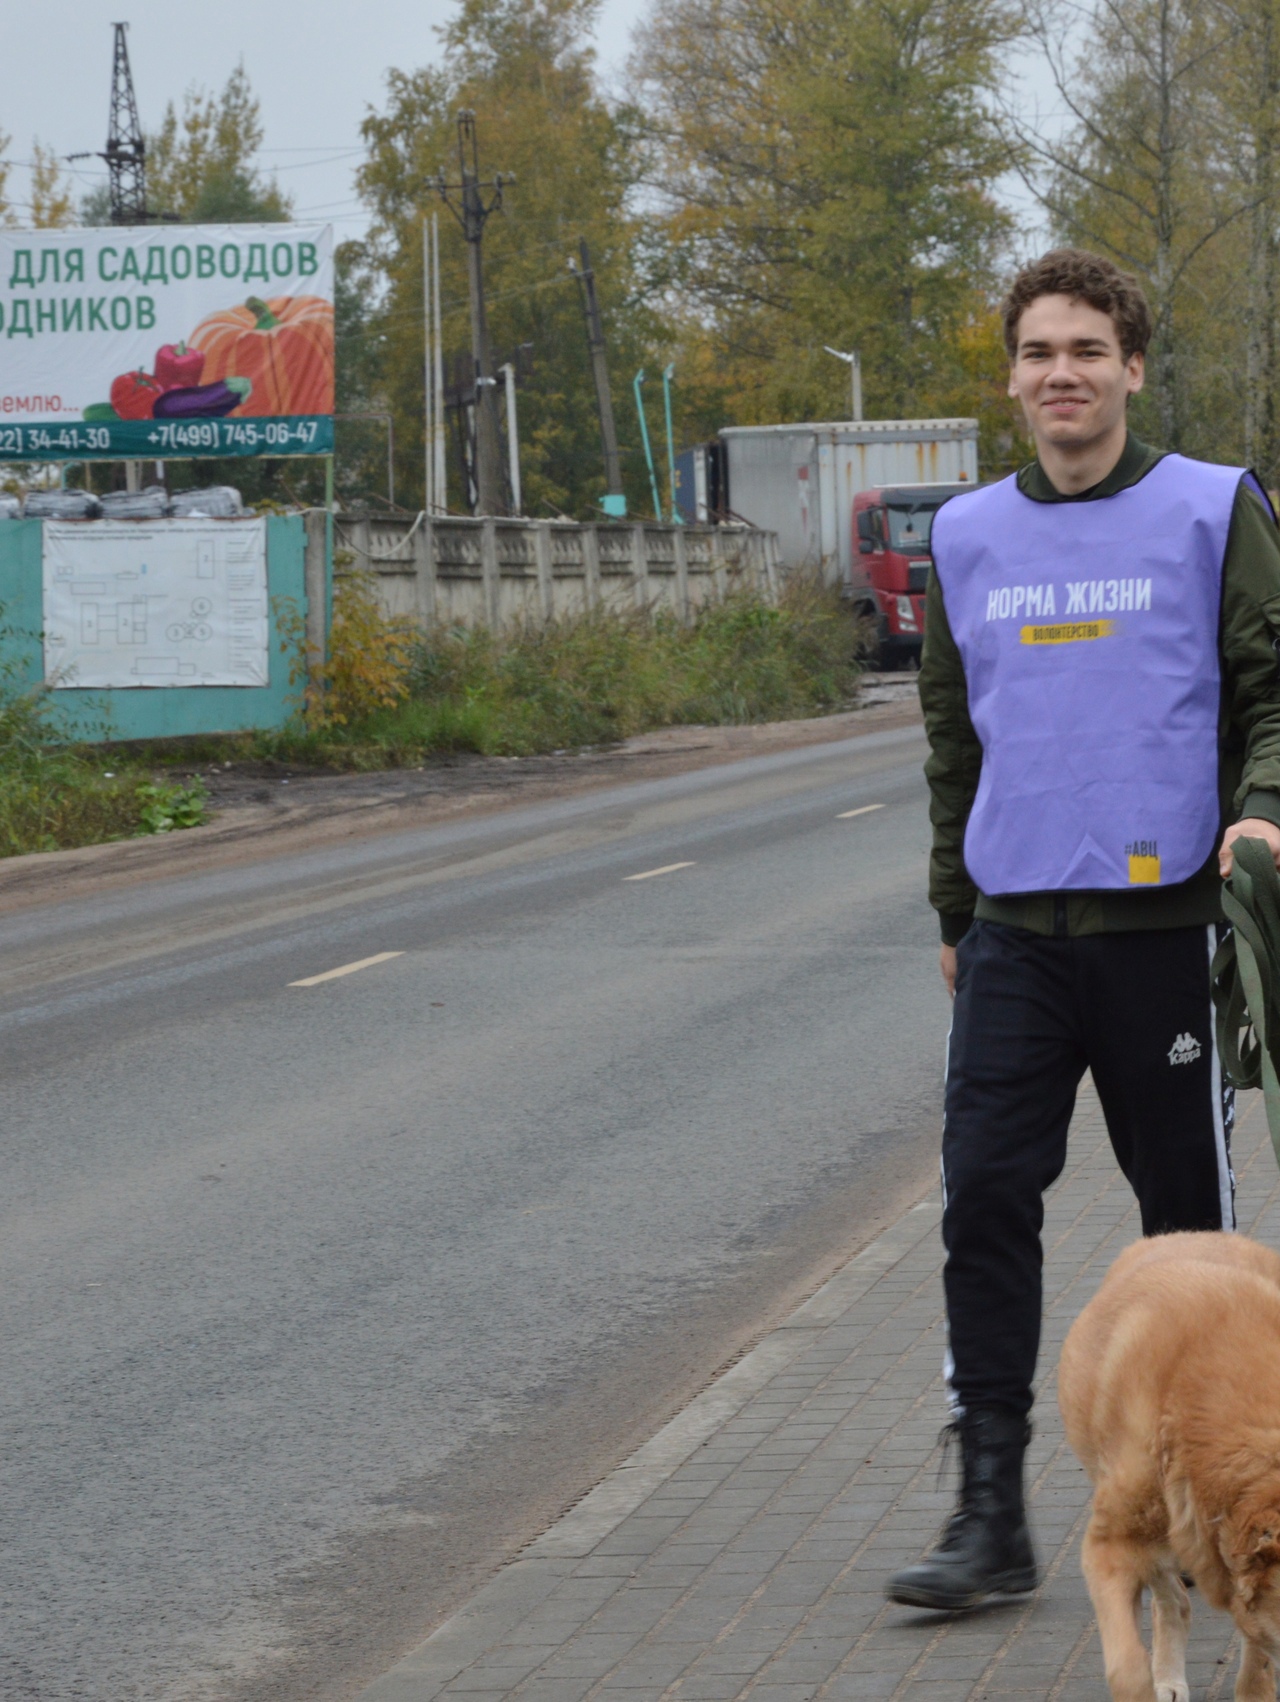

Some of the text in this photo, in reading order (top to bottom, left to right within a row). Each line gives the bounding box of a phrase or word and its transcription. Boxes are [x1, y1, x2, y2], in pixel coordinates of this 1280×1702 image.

[9, 241, 319, 289] ДЛЯ САДОВОДОВ
[0, 295, 156, 339] ДНИКОВ
[0, 395, 79, 413] емлю...
[0, 421, 318, 453] 2) 34-41-30 +7(499) 745-06-47
[986, 578, 1152, 622] НОРМА ЖИЗНИ
[1033, 624, 1099, 641] ВОЛОНТЕРСТВО
